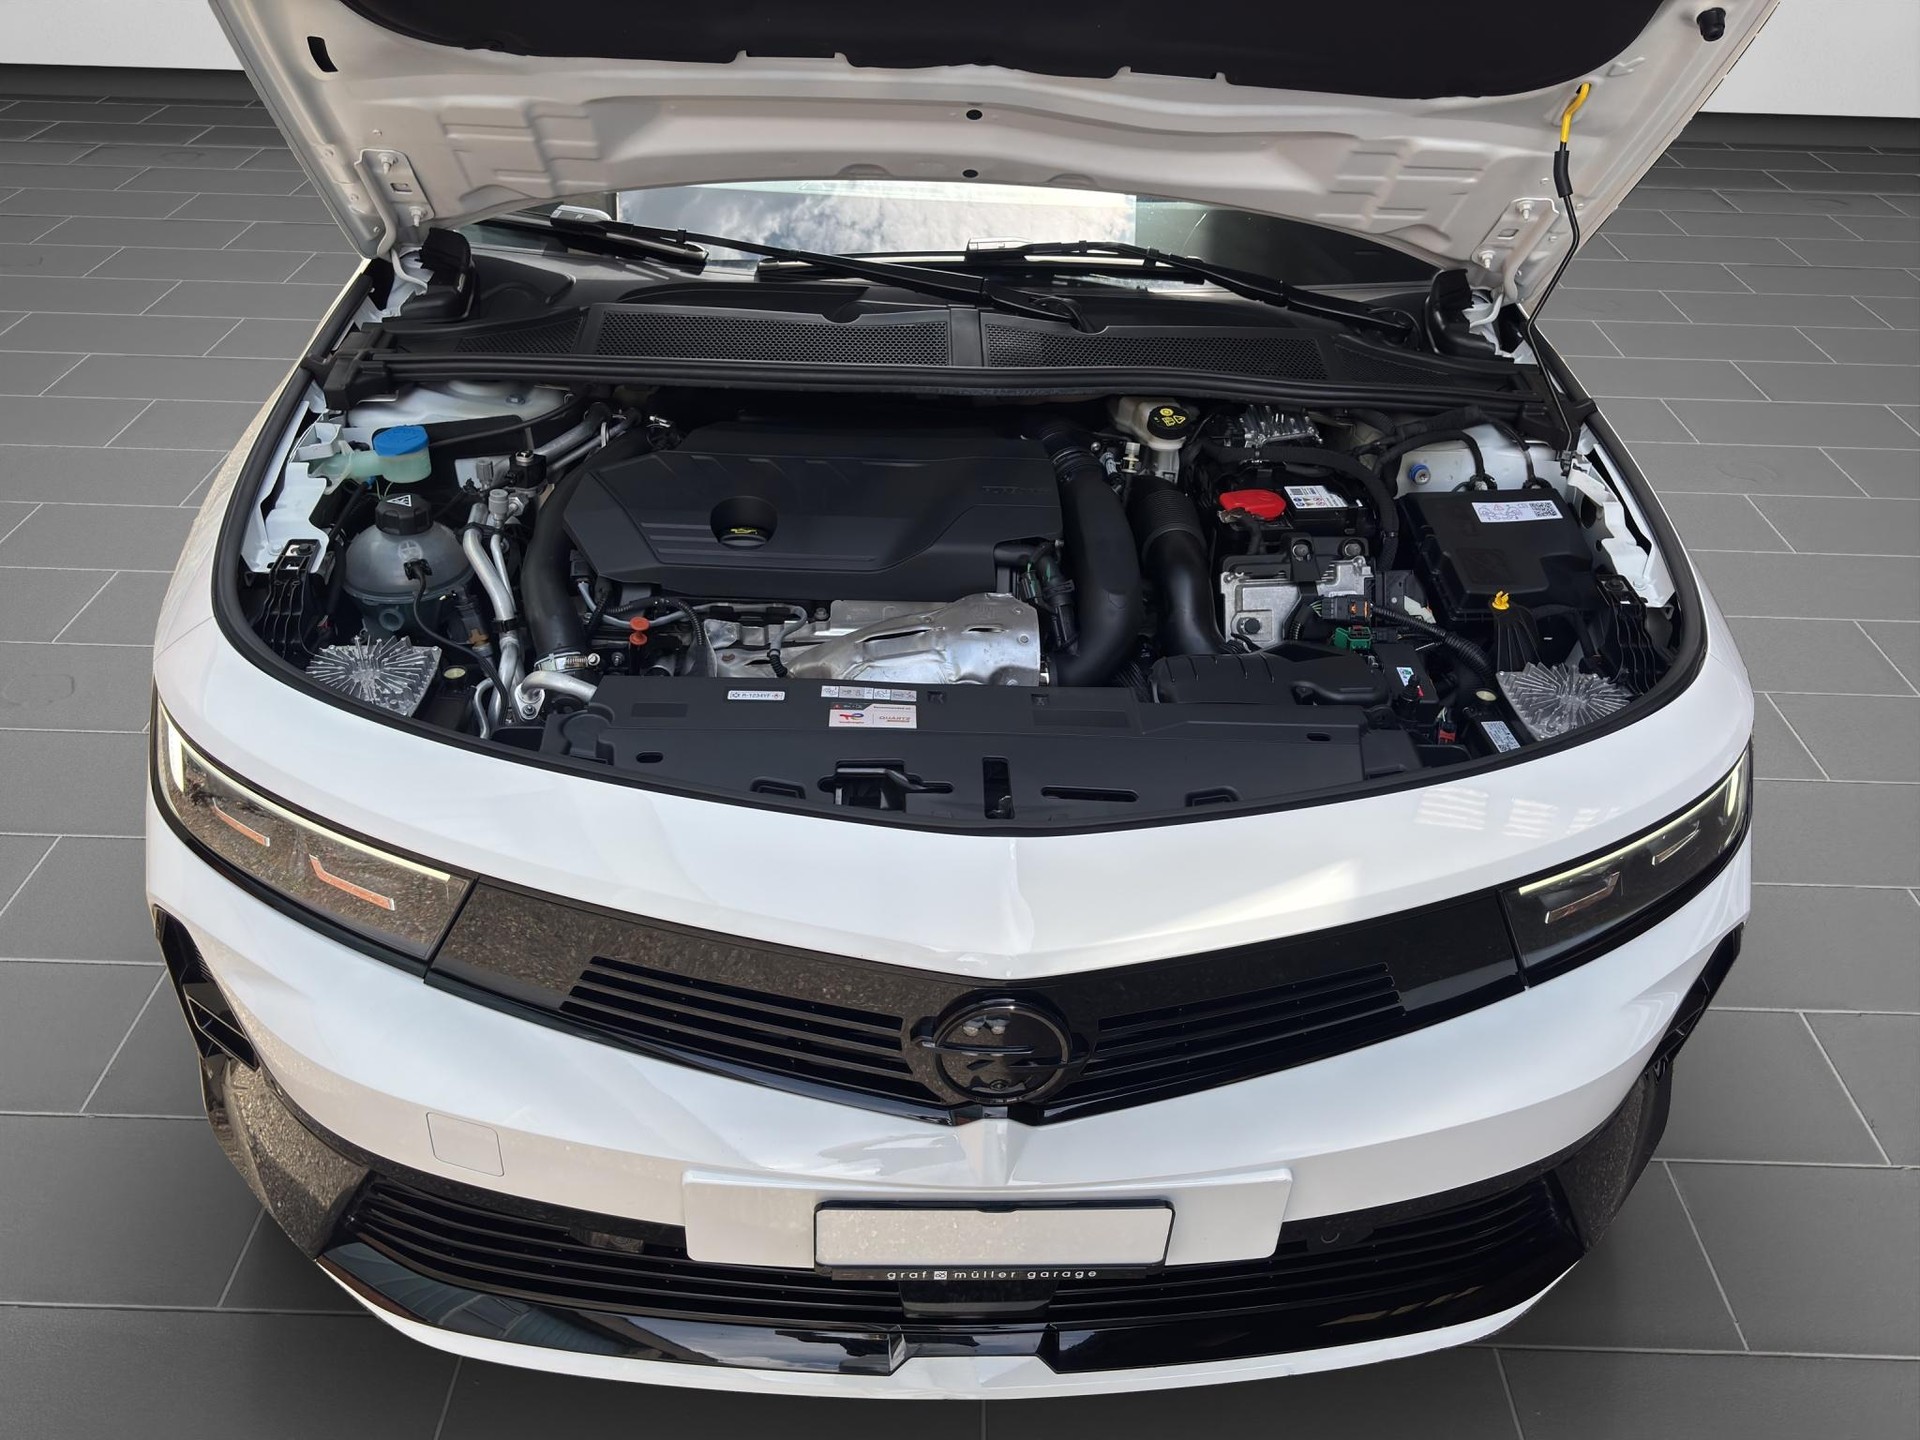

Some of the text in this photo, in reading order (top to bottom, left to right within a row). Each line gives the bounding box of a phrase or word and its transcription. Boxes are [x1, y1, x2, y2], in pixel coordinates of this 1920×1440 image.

[886, 1270, 927, 1280] graf
[954, 1270, 1016, 1279] müller
[1027, 1270, 1097, 1280] garage
